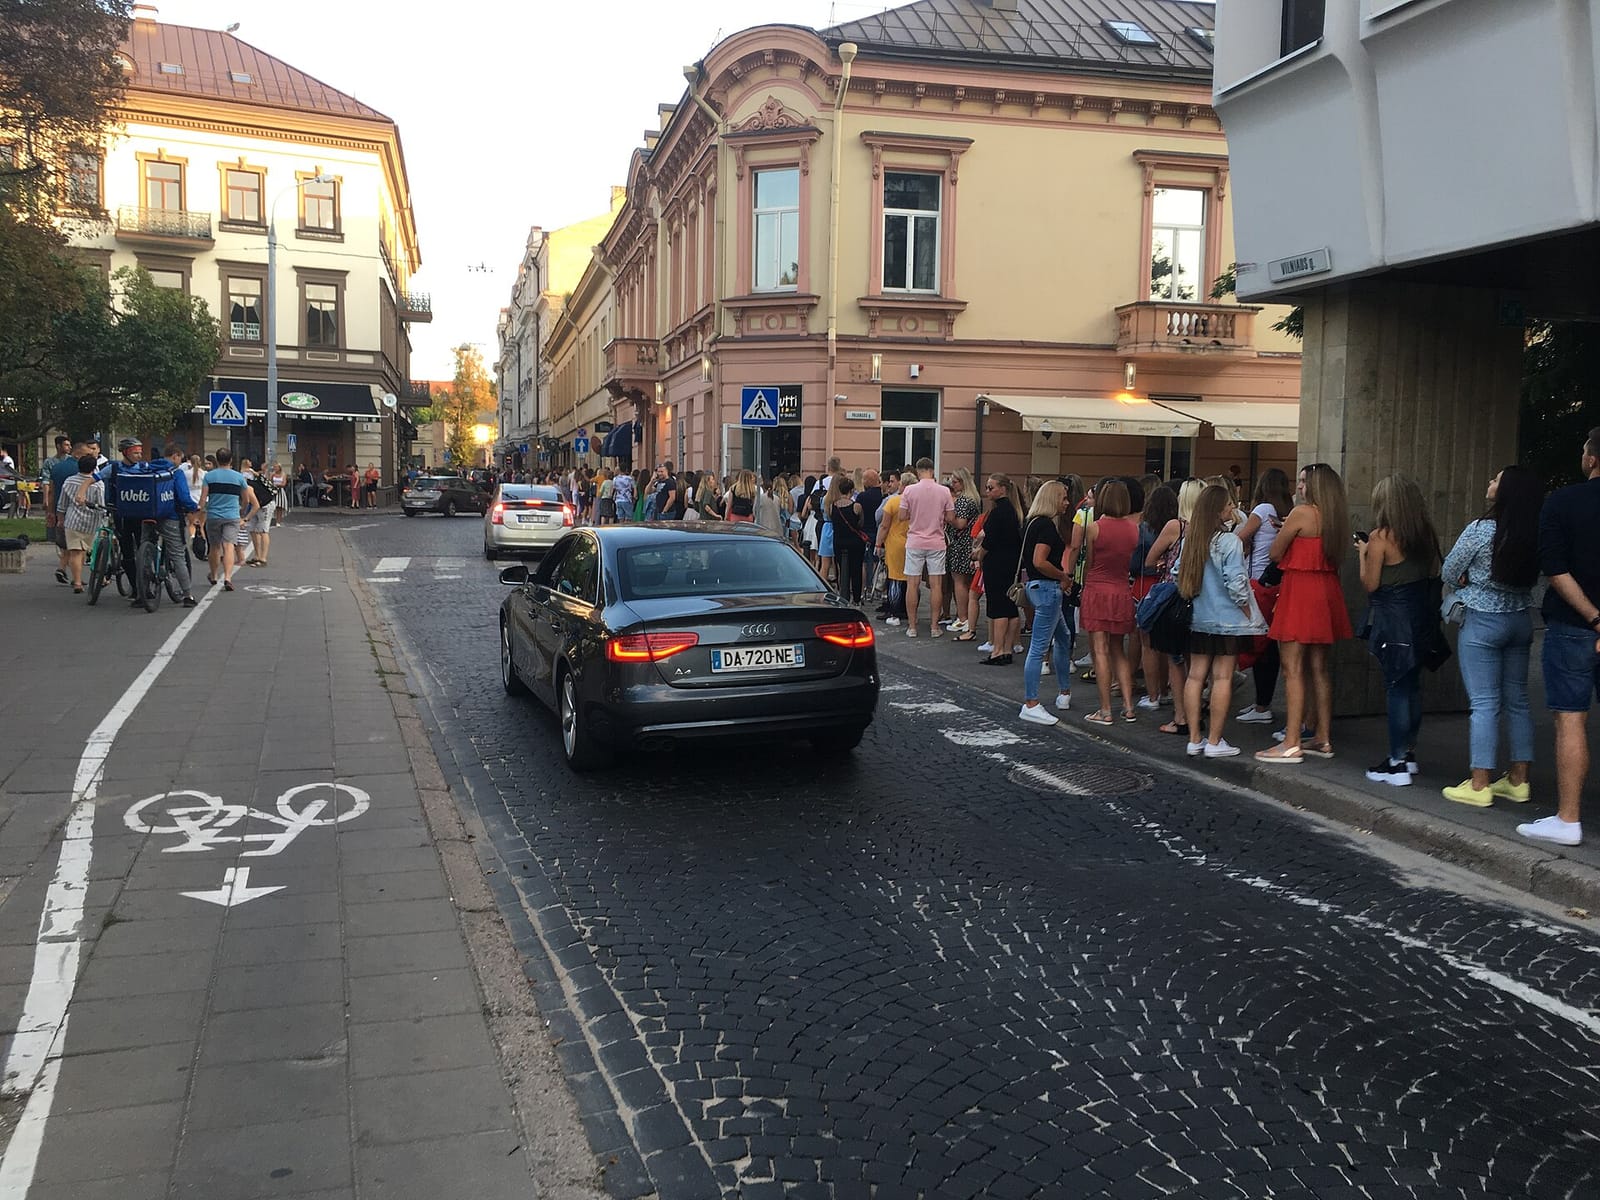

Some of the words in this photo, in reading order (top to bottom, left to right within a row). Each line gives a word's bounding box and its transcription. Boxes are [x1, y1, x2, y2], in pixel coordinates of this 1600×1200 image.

[1280, 257, 1308, 275] VILNIAUS
[780, 395, 797, 407] utti
[120, 489, 150, 502] Wolt
